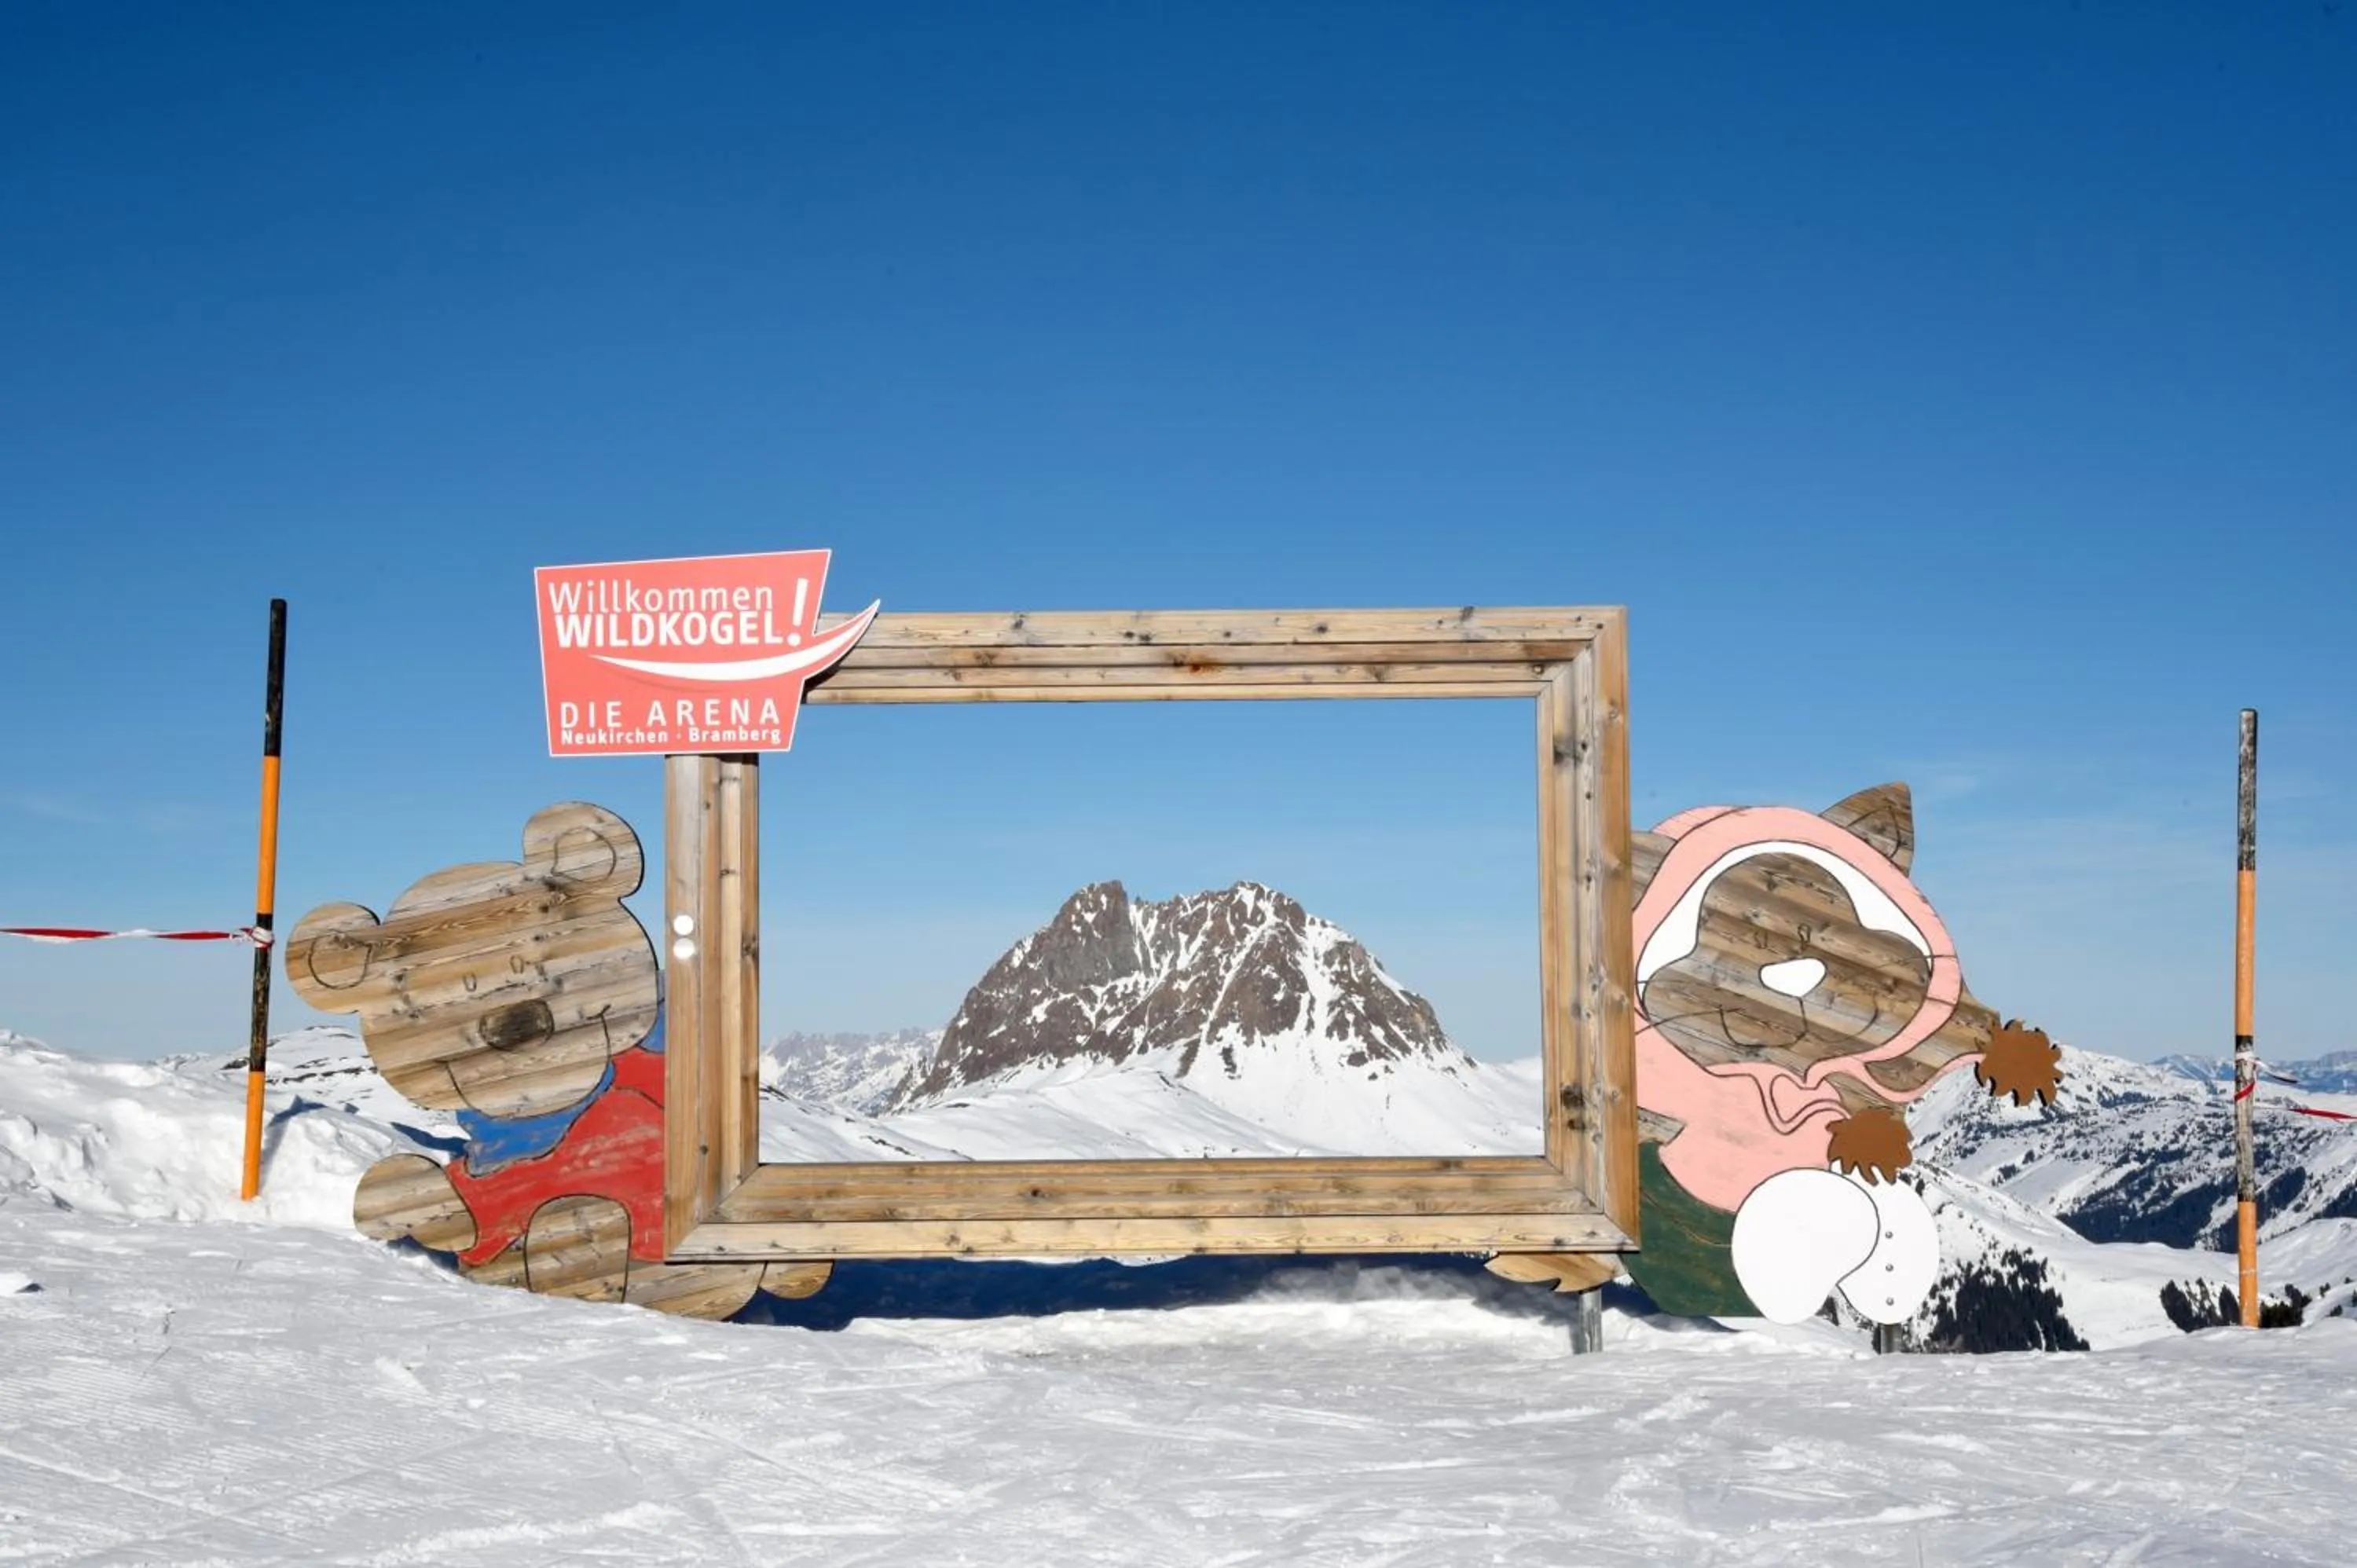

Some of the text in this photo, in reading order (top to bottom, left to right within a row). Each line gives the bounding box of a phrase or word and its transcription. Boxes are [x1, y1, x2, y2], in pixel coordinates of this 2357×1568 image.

[549, 580, 773, 614] Willkommen
[560, 699, 780, 728] DIE ARENA
[561, 727, 668, 745] Neukirchen
[689, 727, 781, 745] Bramberg
